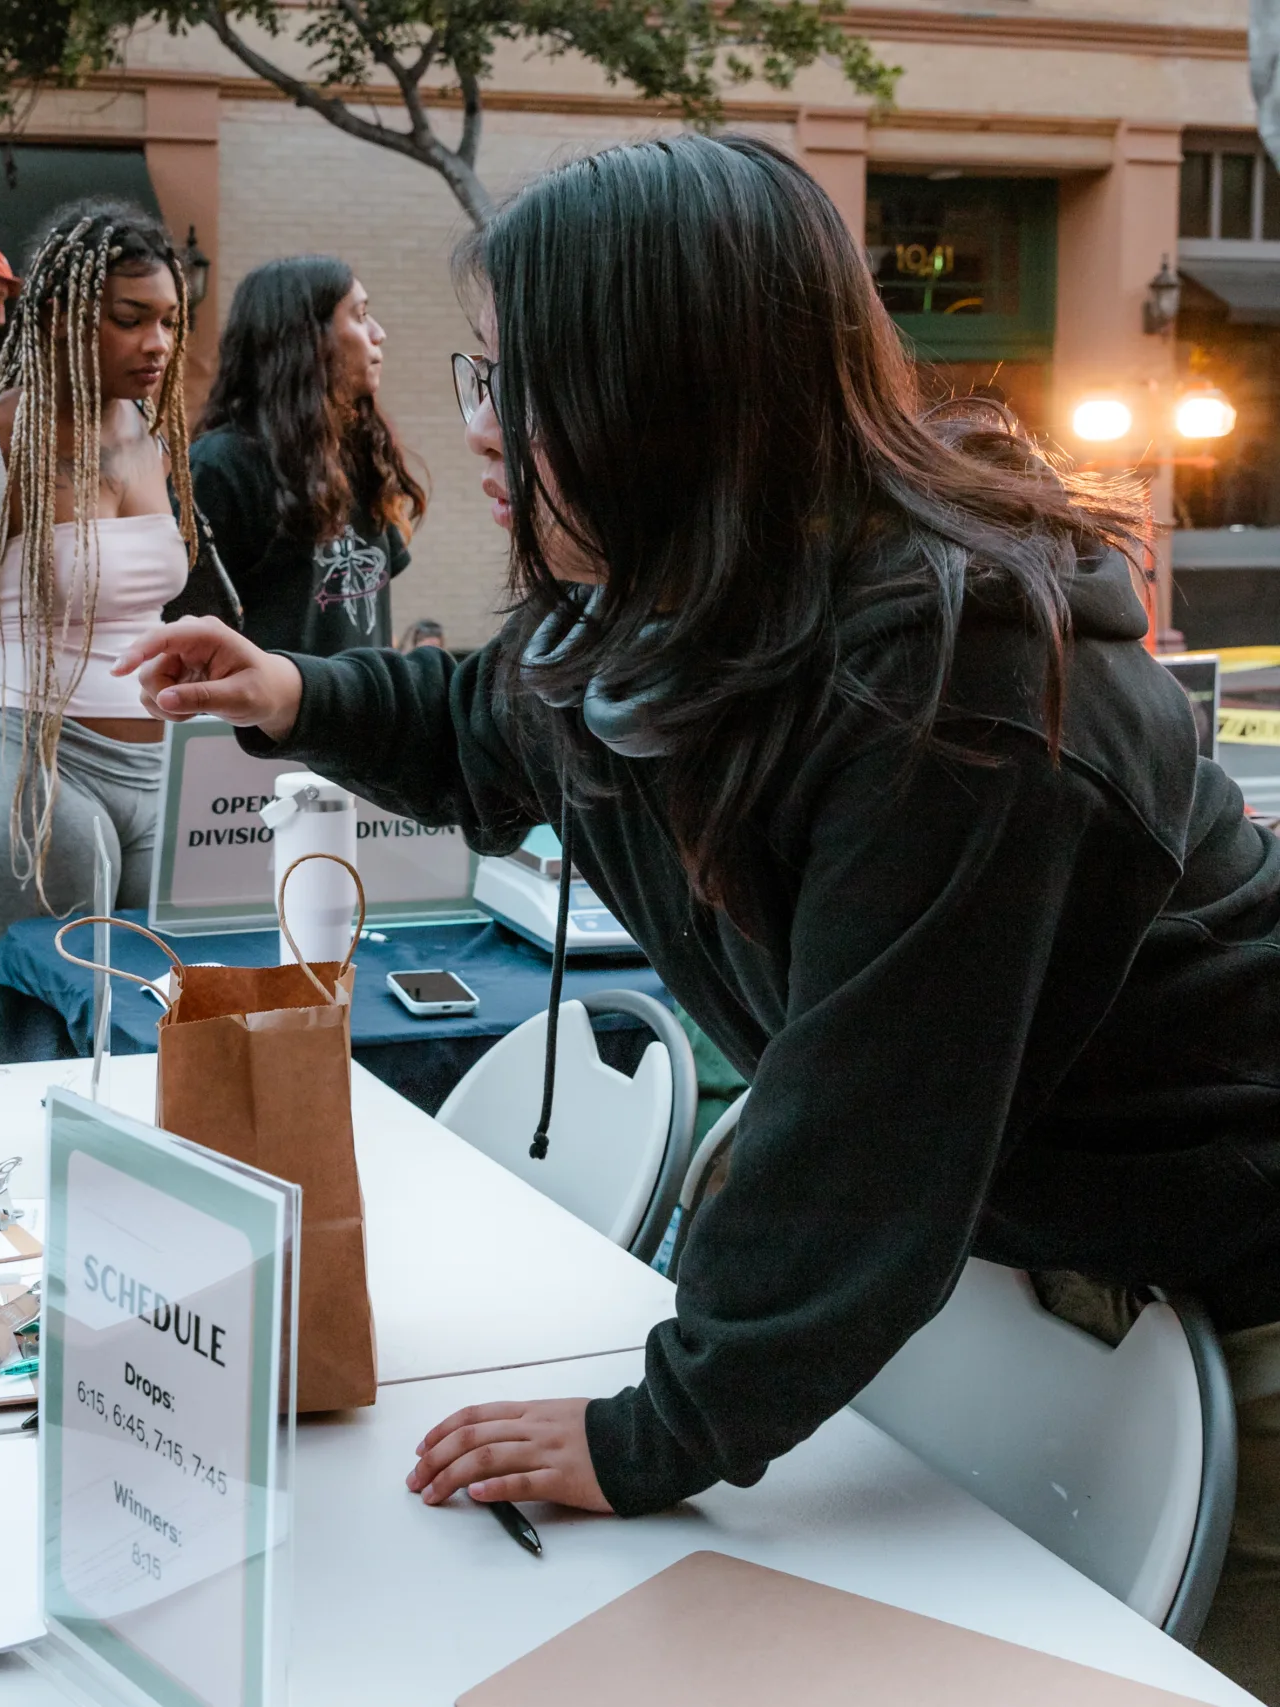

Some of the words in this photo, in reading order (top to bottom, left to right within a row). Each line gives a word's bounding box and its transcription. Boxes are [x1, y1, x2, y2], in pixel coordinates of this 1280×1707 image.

[188, 827, 274, 847] DIVISIO
[84, 1254, 226, 1367] SCHEDULE
[124, 1361, 175, 1412] Drops:
[77, 1380, 109, 1422] 6:15,
[113, 1404, 149, 1449] 6:45,
[154, 1428, 187, 1475] 7:15,
[192, 1454, 228, 1495] 7:45
[113, 1480, 182, 1547] Winners:
[132, 1541, 162, 1580] 8:15
